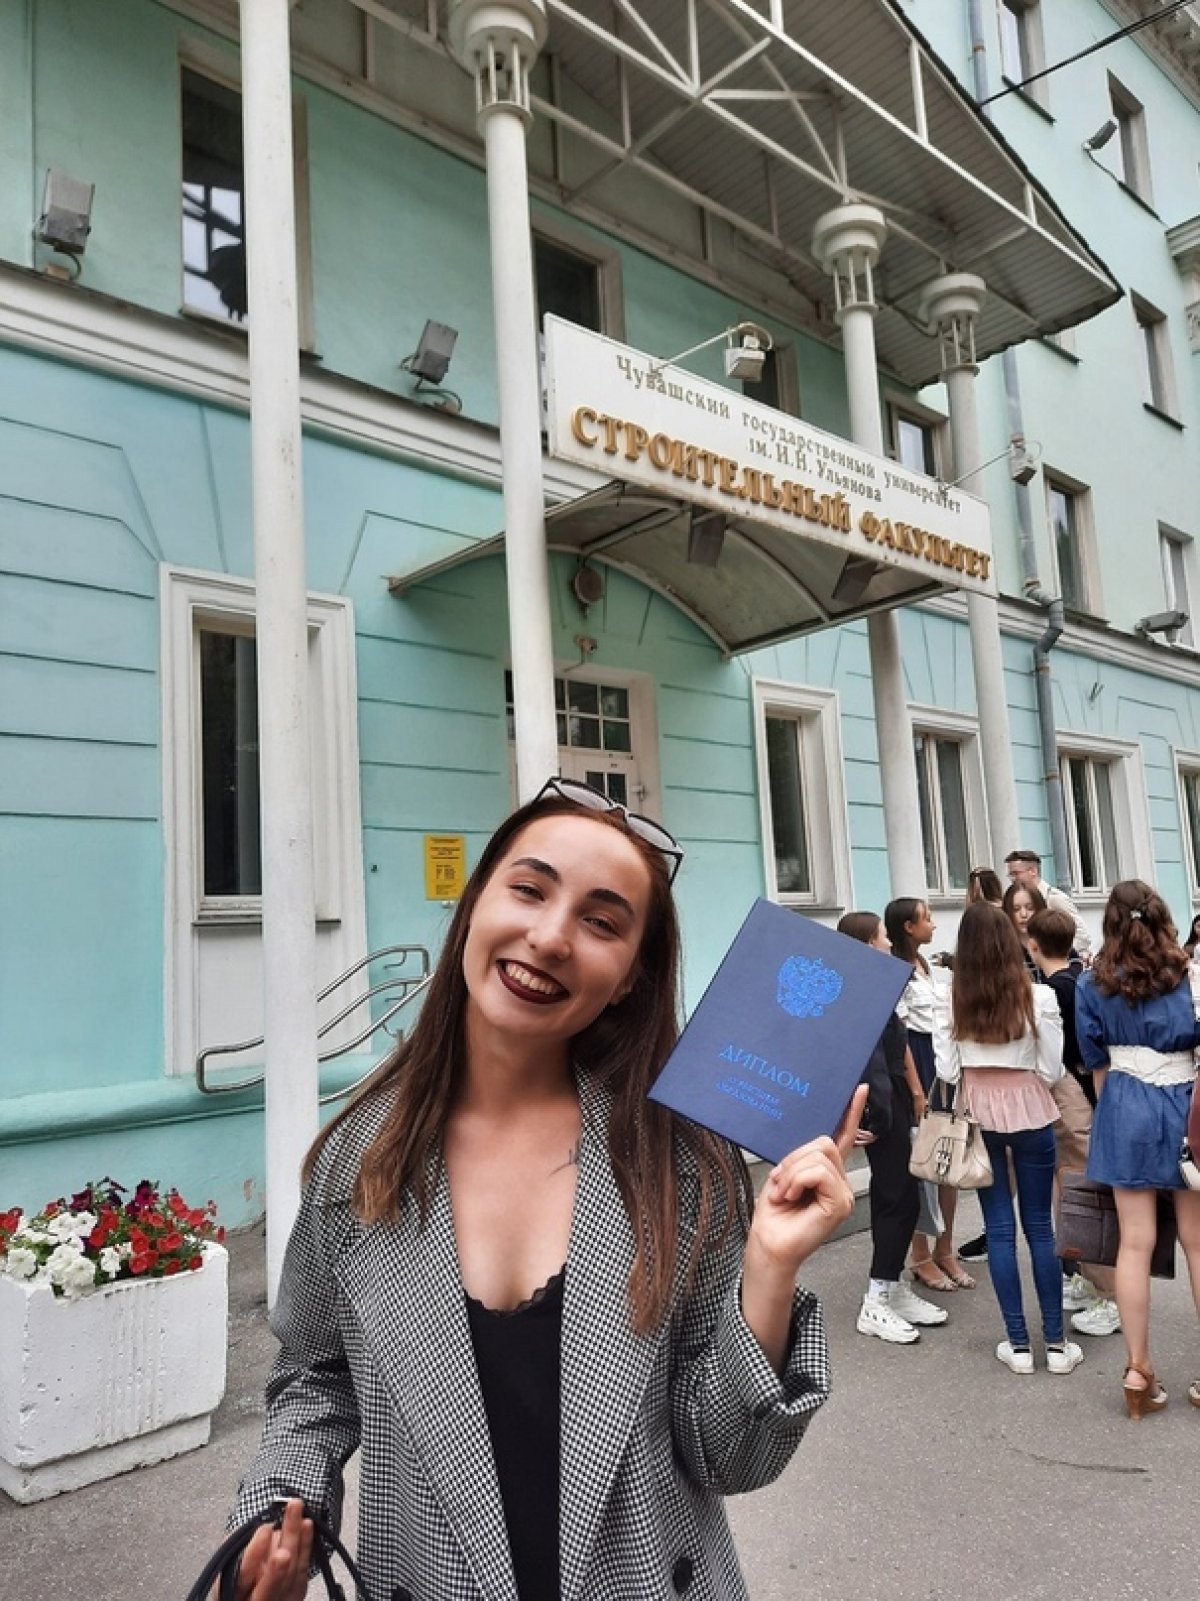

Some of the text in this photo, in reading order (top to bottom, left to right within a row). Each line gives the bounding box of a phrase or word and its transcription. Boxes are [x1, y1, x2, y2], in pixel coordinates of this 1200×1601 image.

[616, 354, 961, 513] Чувашский государственный университет
[816, 459, 882, 502] Ульянова
[571, 405, 990, 581] СТРОИТЕЛЬНЫЙ ФАКУЛЬТЕТ
[719, 1044, 811, 1098] ДИПЛОМ
